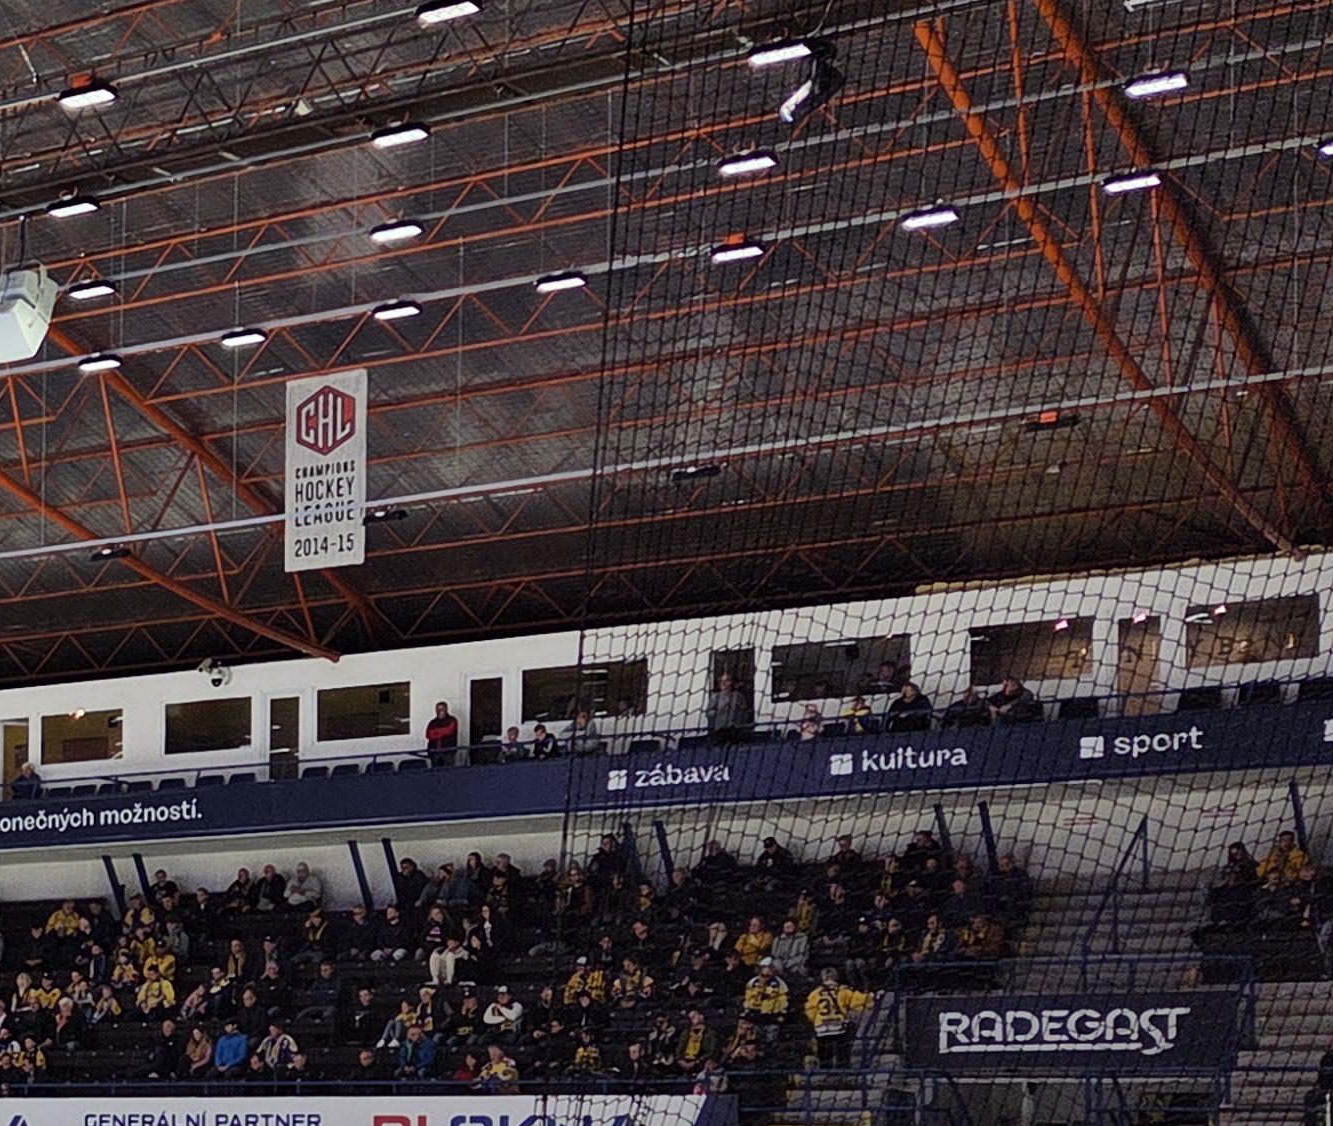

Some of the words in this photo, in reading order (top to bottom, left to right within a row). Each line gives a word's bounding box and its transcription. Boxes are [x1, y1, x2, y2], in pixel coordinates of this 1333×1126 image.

[301, 391, 352, 449] CHL
[295, 460, 356, 480] CHAMPIONS
[295, 476, 355, 503] HOCKEY
[294, 533, 355, 558] 2014-15
[1113, 726, 1204, 758] sport
[861, 745, 968, 772] kultura
[635, 762, 730, 787] zábava
[99, 797, 204, 827] možností.
[939, 1006, 1191, 1054] RADEGAST
